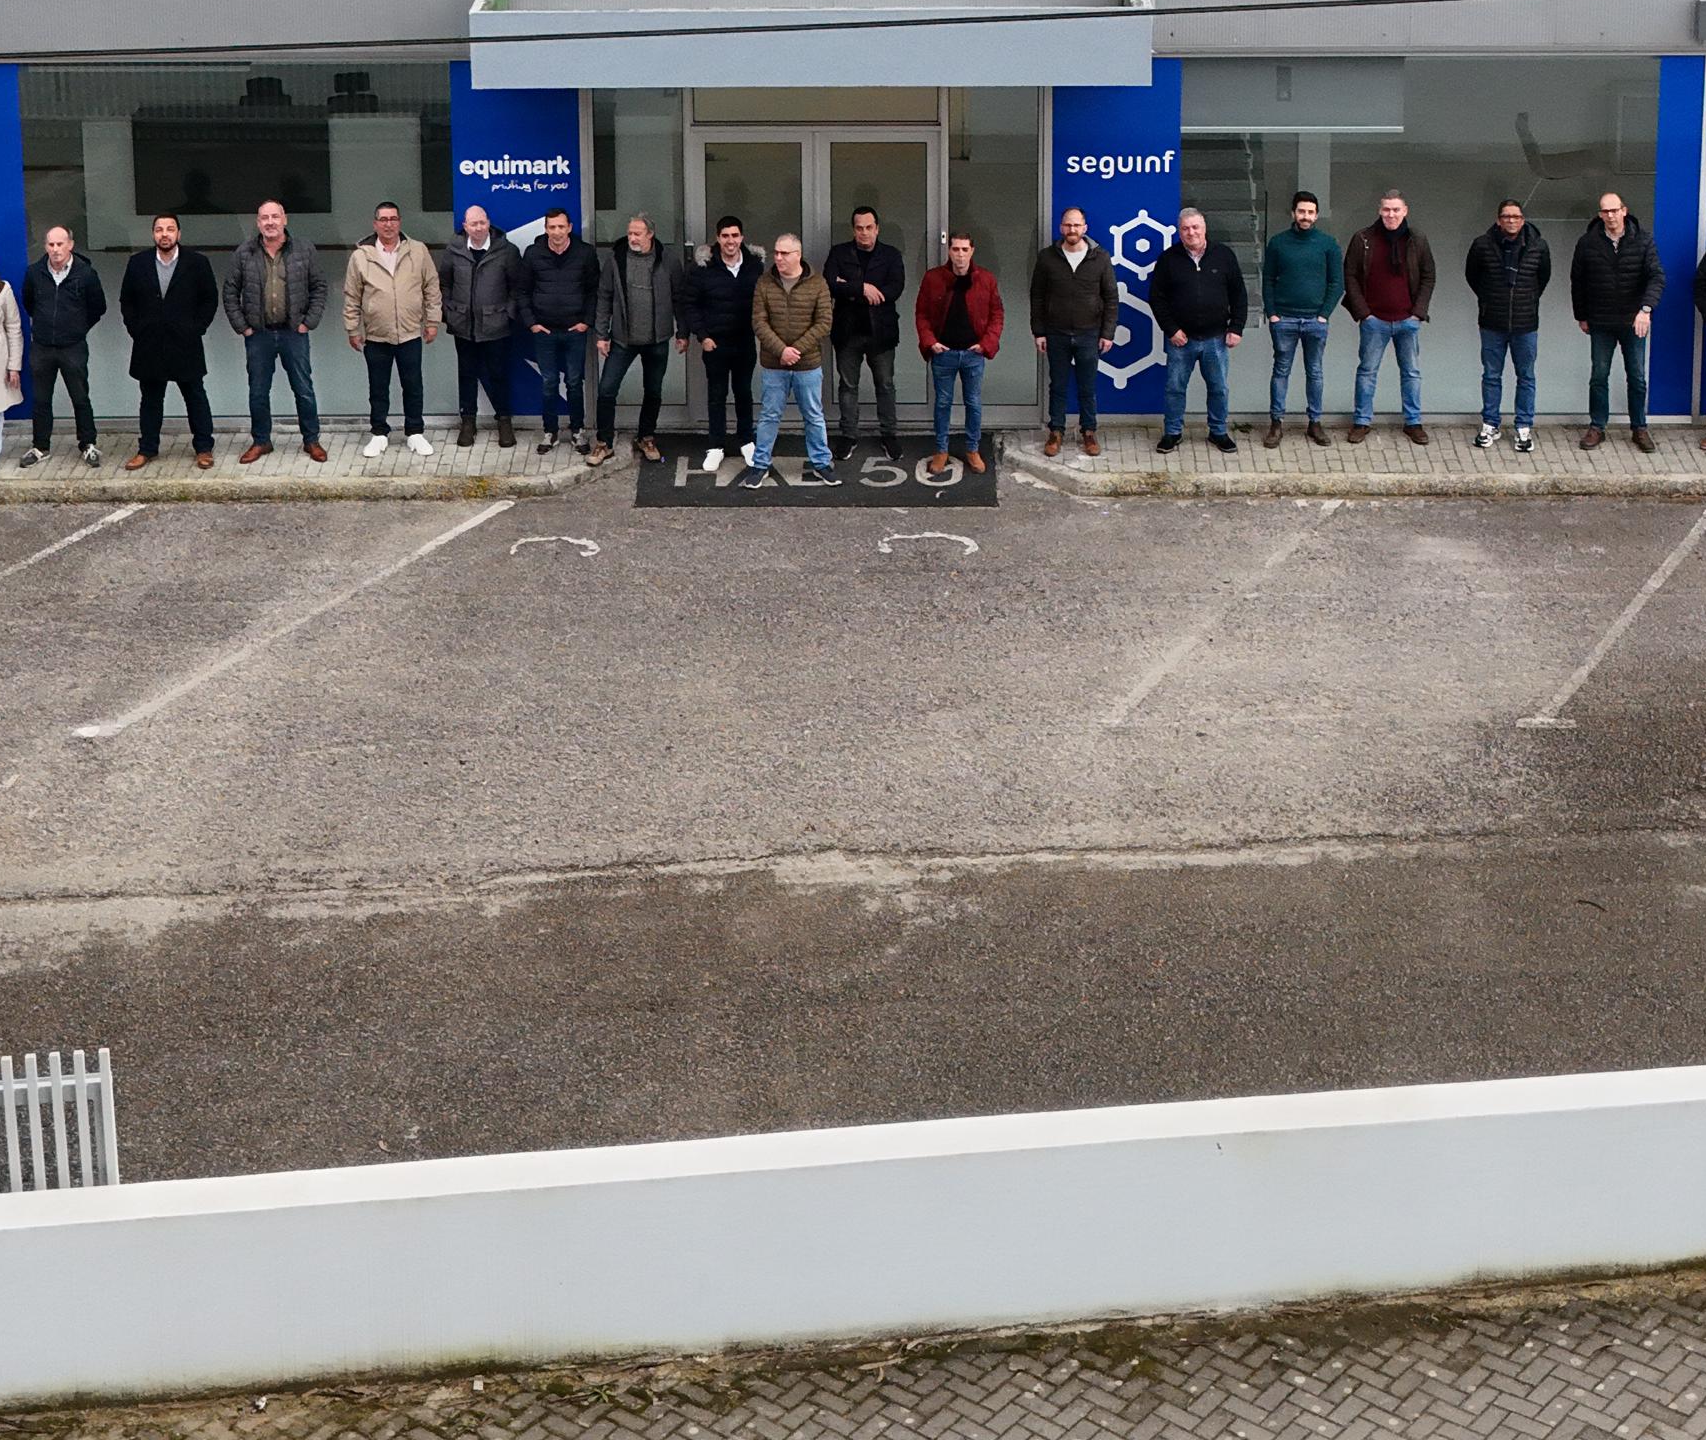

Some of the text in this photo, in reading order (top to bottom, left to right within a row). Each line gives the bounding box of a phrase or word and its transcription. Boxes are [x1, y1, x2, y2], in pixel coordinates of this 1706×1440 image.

[459, 153, 571, 180] equimark
[1066, 150, 1176, 180] seguinf
[533, 179, 548, 191] for
[550, 182, 569, 192] you
